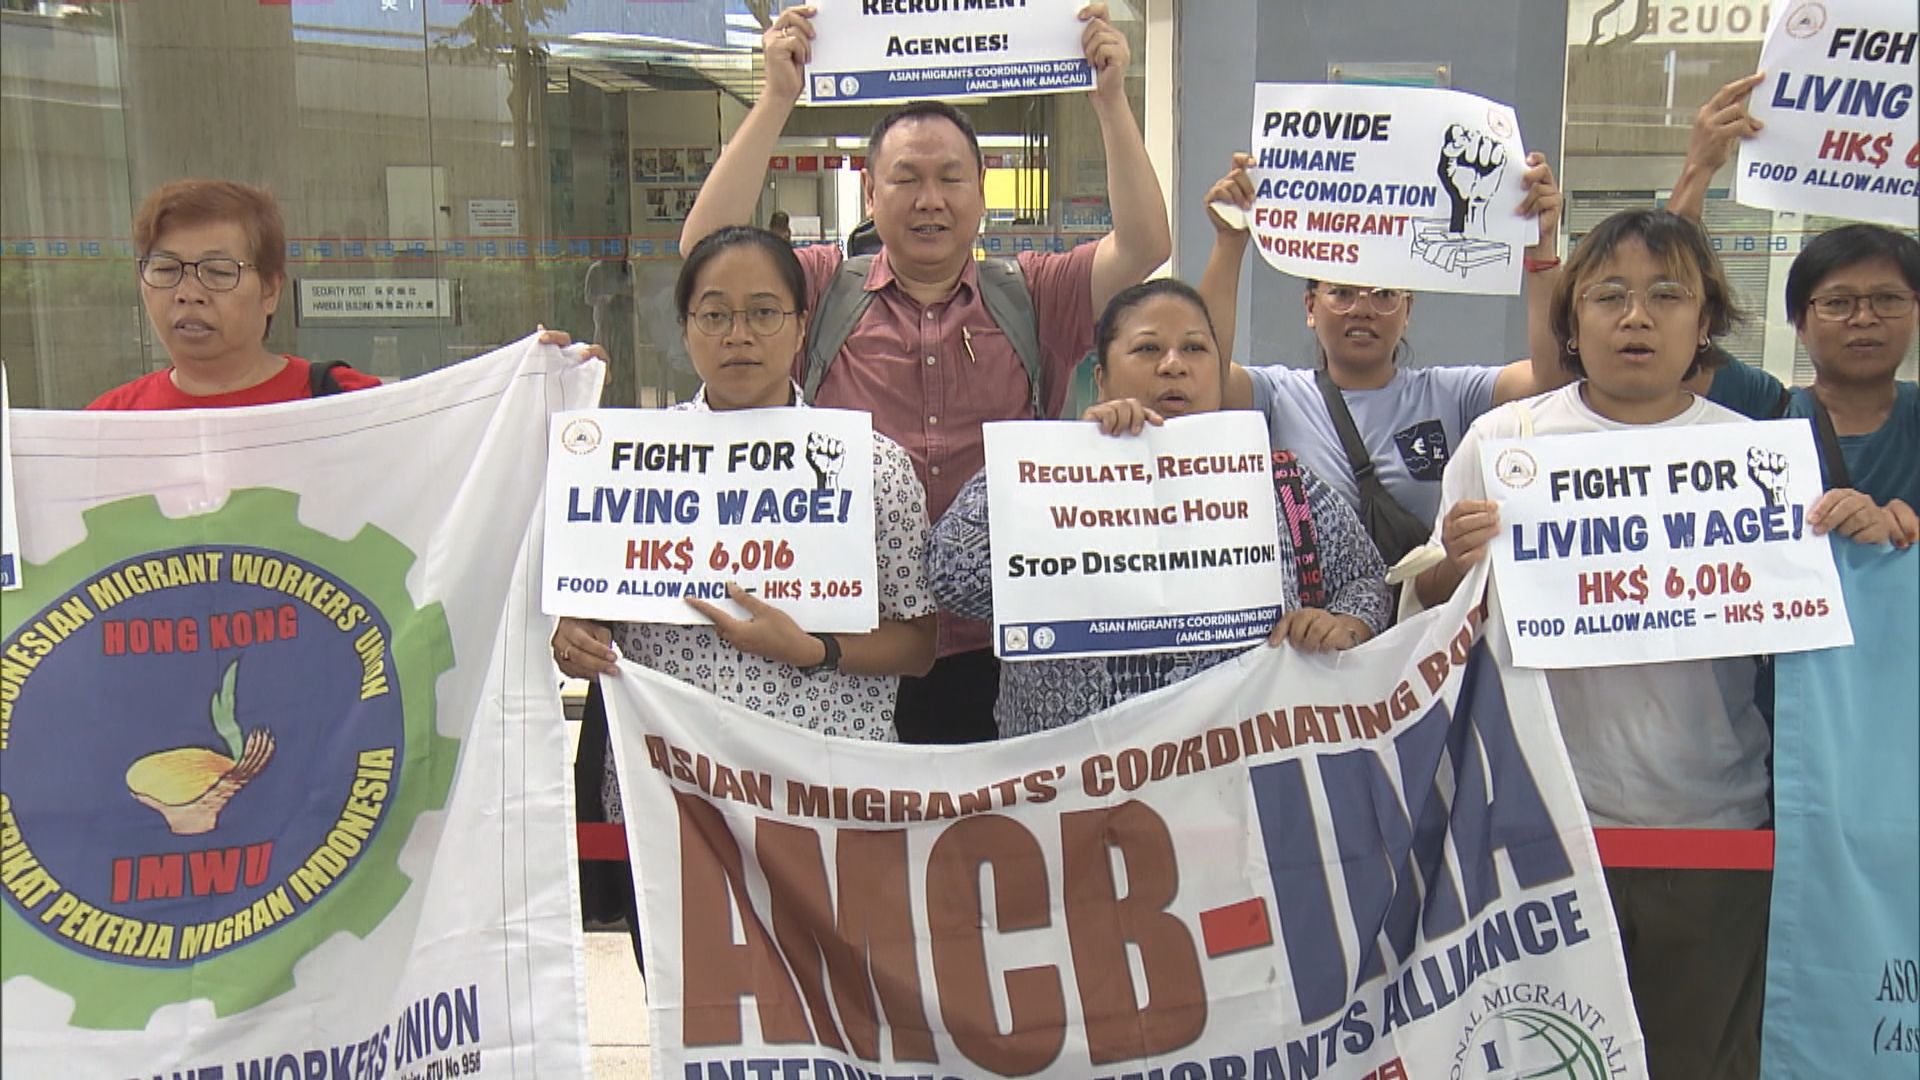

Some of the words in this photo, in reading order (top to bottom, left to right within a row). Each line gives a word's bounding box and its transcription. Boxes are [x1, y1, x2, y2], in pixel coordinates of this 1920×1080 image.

[886, 33, 1009, 57] AGENCIES!
[889, 71, 920, 82] ASIAN
[921, 68, 974, 81] MIGRANTS
[975, 63, 1051, 78] COORDINATING
[1053, 61, 1080, 73] BODY
[1023, 77, 1037, 88] HK
[1771, 72, 1913, 119] LIVING
[1263, 111, 1391, 141] PROVIDE
[1258, 148, 1356, 171] HUMANE
[1818, 130, 1893, 168] HK$
[1748, 162, 1798, 182] FOOD
[1256, 179, 1437, 207] ACCOMODATION
[1255, 208, 1298, 229] FOR
[1307, 211, 1409, 236] MIGRANT
[1257, 234, 1359, 263] WORKERS
[312, 286, 344, 296] SECURITY
[348, 286, 366, 296] POST
[611, 441, 713, 474] FIGHT
[728, 441, 795, 472] FOR
[1018, 460, 1153, 486] REGULATE,
[1157, 453, 1265, 479] REGULATE
[1550, 465, 1651, 502] FIGHT
[1668, 460, 1737, 493] FOR
[567, 487, 700, 524] LIVING
[717, 488, 853, 525] WAGE!
[1050, 502, 1177, 529] WORKING
[1183, 498, 1249, 520] HOUR
[1513, 514, 1648, 561] LIVING
[1663, 504, 1805, 550] WAGE!
[625, 536, 694, 574] HK$
[709, 539, 795, 574] 6,016
[1008, 553, 1076, 578] STOP
[1082, 543, 1275, 575] DISCRIMINATION!
[557, 577, 608, 594] FOOD
[764, 578, 801, 600] HK$
[810, 579, 863, 599] 3,065
[1578, 565, 1648, 605] HK$
[1665, 562, 1752, 600] 6,016
[103, 618, 198, 656] HONG
[209, 604, 298, 649] KONG
[1090, 622, 1125, 634] ASIAN
[1127, 618, 1185, 631] MIGRANTS
[1186, 611, 1256, 628] COORDINATING
[1257, 609, 1277, 621] BODY
[1517, 618, 1565, 637] FOOD
[1574, 609, 1696, 634] ALLOWANCE
[1725, 601, 1764, 624] HK$
[1773, 598, 1829, 619] 3,065
[0, 597, 95, 750] ONESIAN
[86, 552, 224, 612] MIGRANT
[231, 553, 372, 632] WORKERS'
[1176, 630, 1234, 645] (AMCB-IMA
[1235, 628, 1246, 639] HK
[644, 735, 773, 810] ASIAN
[787, 766, 1066, 823] MIGRANTS'
[1082, 682, 1420, 793] COORDINATING
[40, 891, 175, 960] PEKERJA
[179, 886, 296, 960] MIGRAN
[288, 747, 395, 903] INDONESIA
[111, 842, 273, 903] IMWU
[1381, 890, 1590, 1036] ALLIANCE
[1483, 983, 1605, 1031] MIGRANT
[395, 984, 481, 1067] UNION
